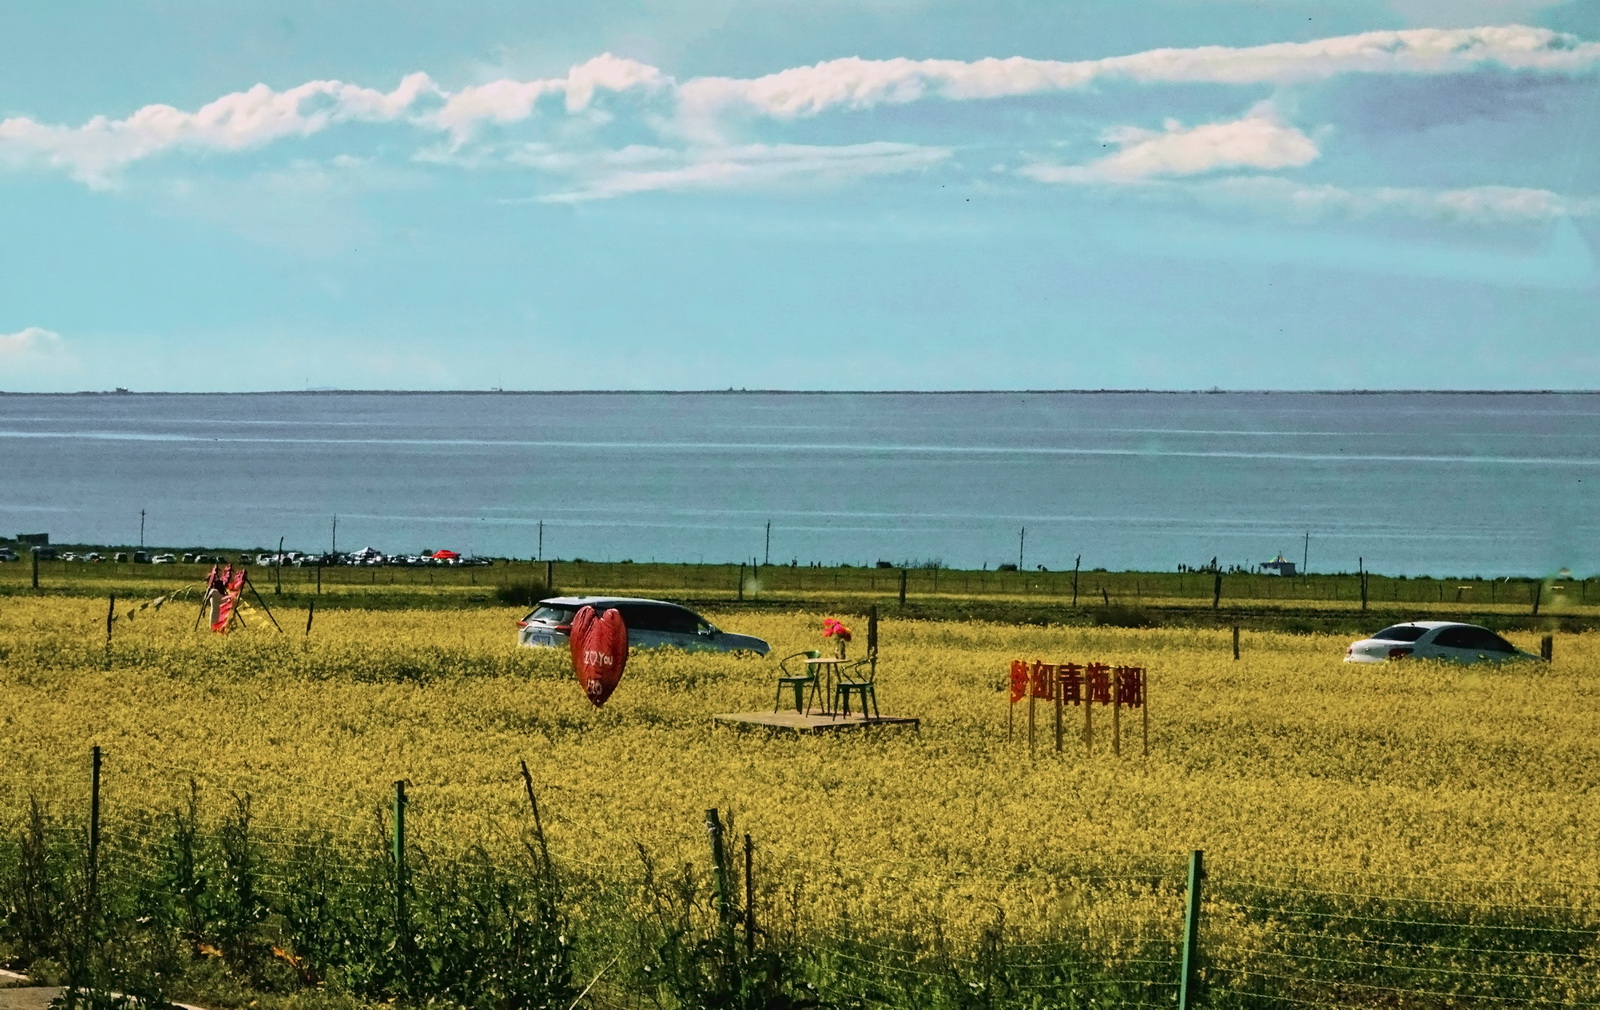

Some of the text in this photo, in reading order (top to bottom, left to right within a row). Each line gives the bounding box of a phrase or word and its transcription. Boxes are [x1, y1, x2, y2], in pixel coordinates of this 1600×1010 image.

[598, 651, 613, 666] You
[1011, 660, 1140, 708] 梦幻青海湖
